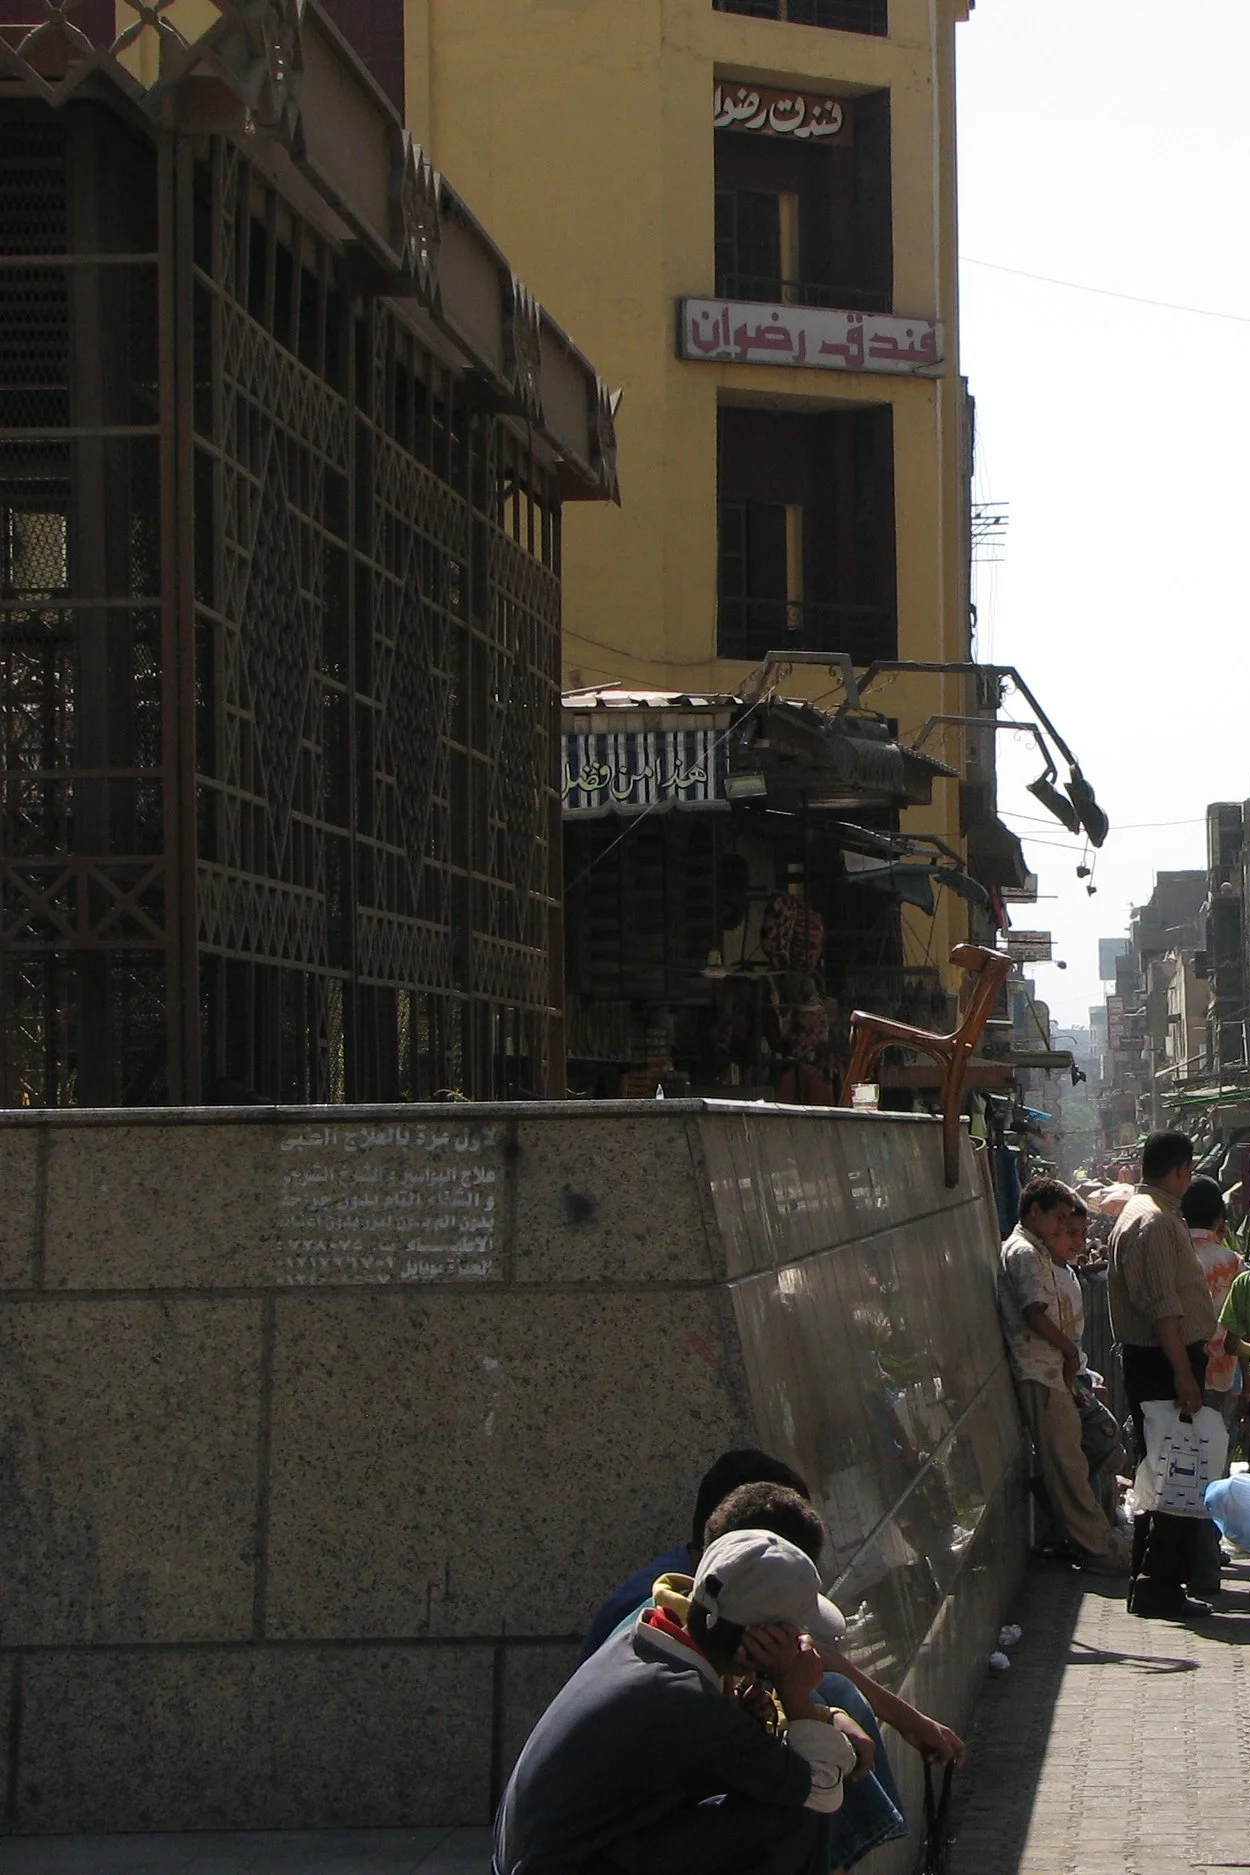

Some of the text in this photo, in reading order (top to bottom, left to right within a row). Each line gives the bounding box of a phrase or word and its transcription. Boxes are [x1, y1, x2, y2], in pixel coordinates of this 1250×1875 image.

[714, 84, 844, 139] فندق رضوا
[690, 307, 938, 368] فندق رضوان
[611, 765, 655, 800] من
[655, 757, 709, 790] هذا
[416, 1124, 449, 1153] مرة
[460, 1167, 496, 1189] علاج
